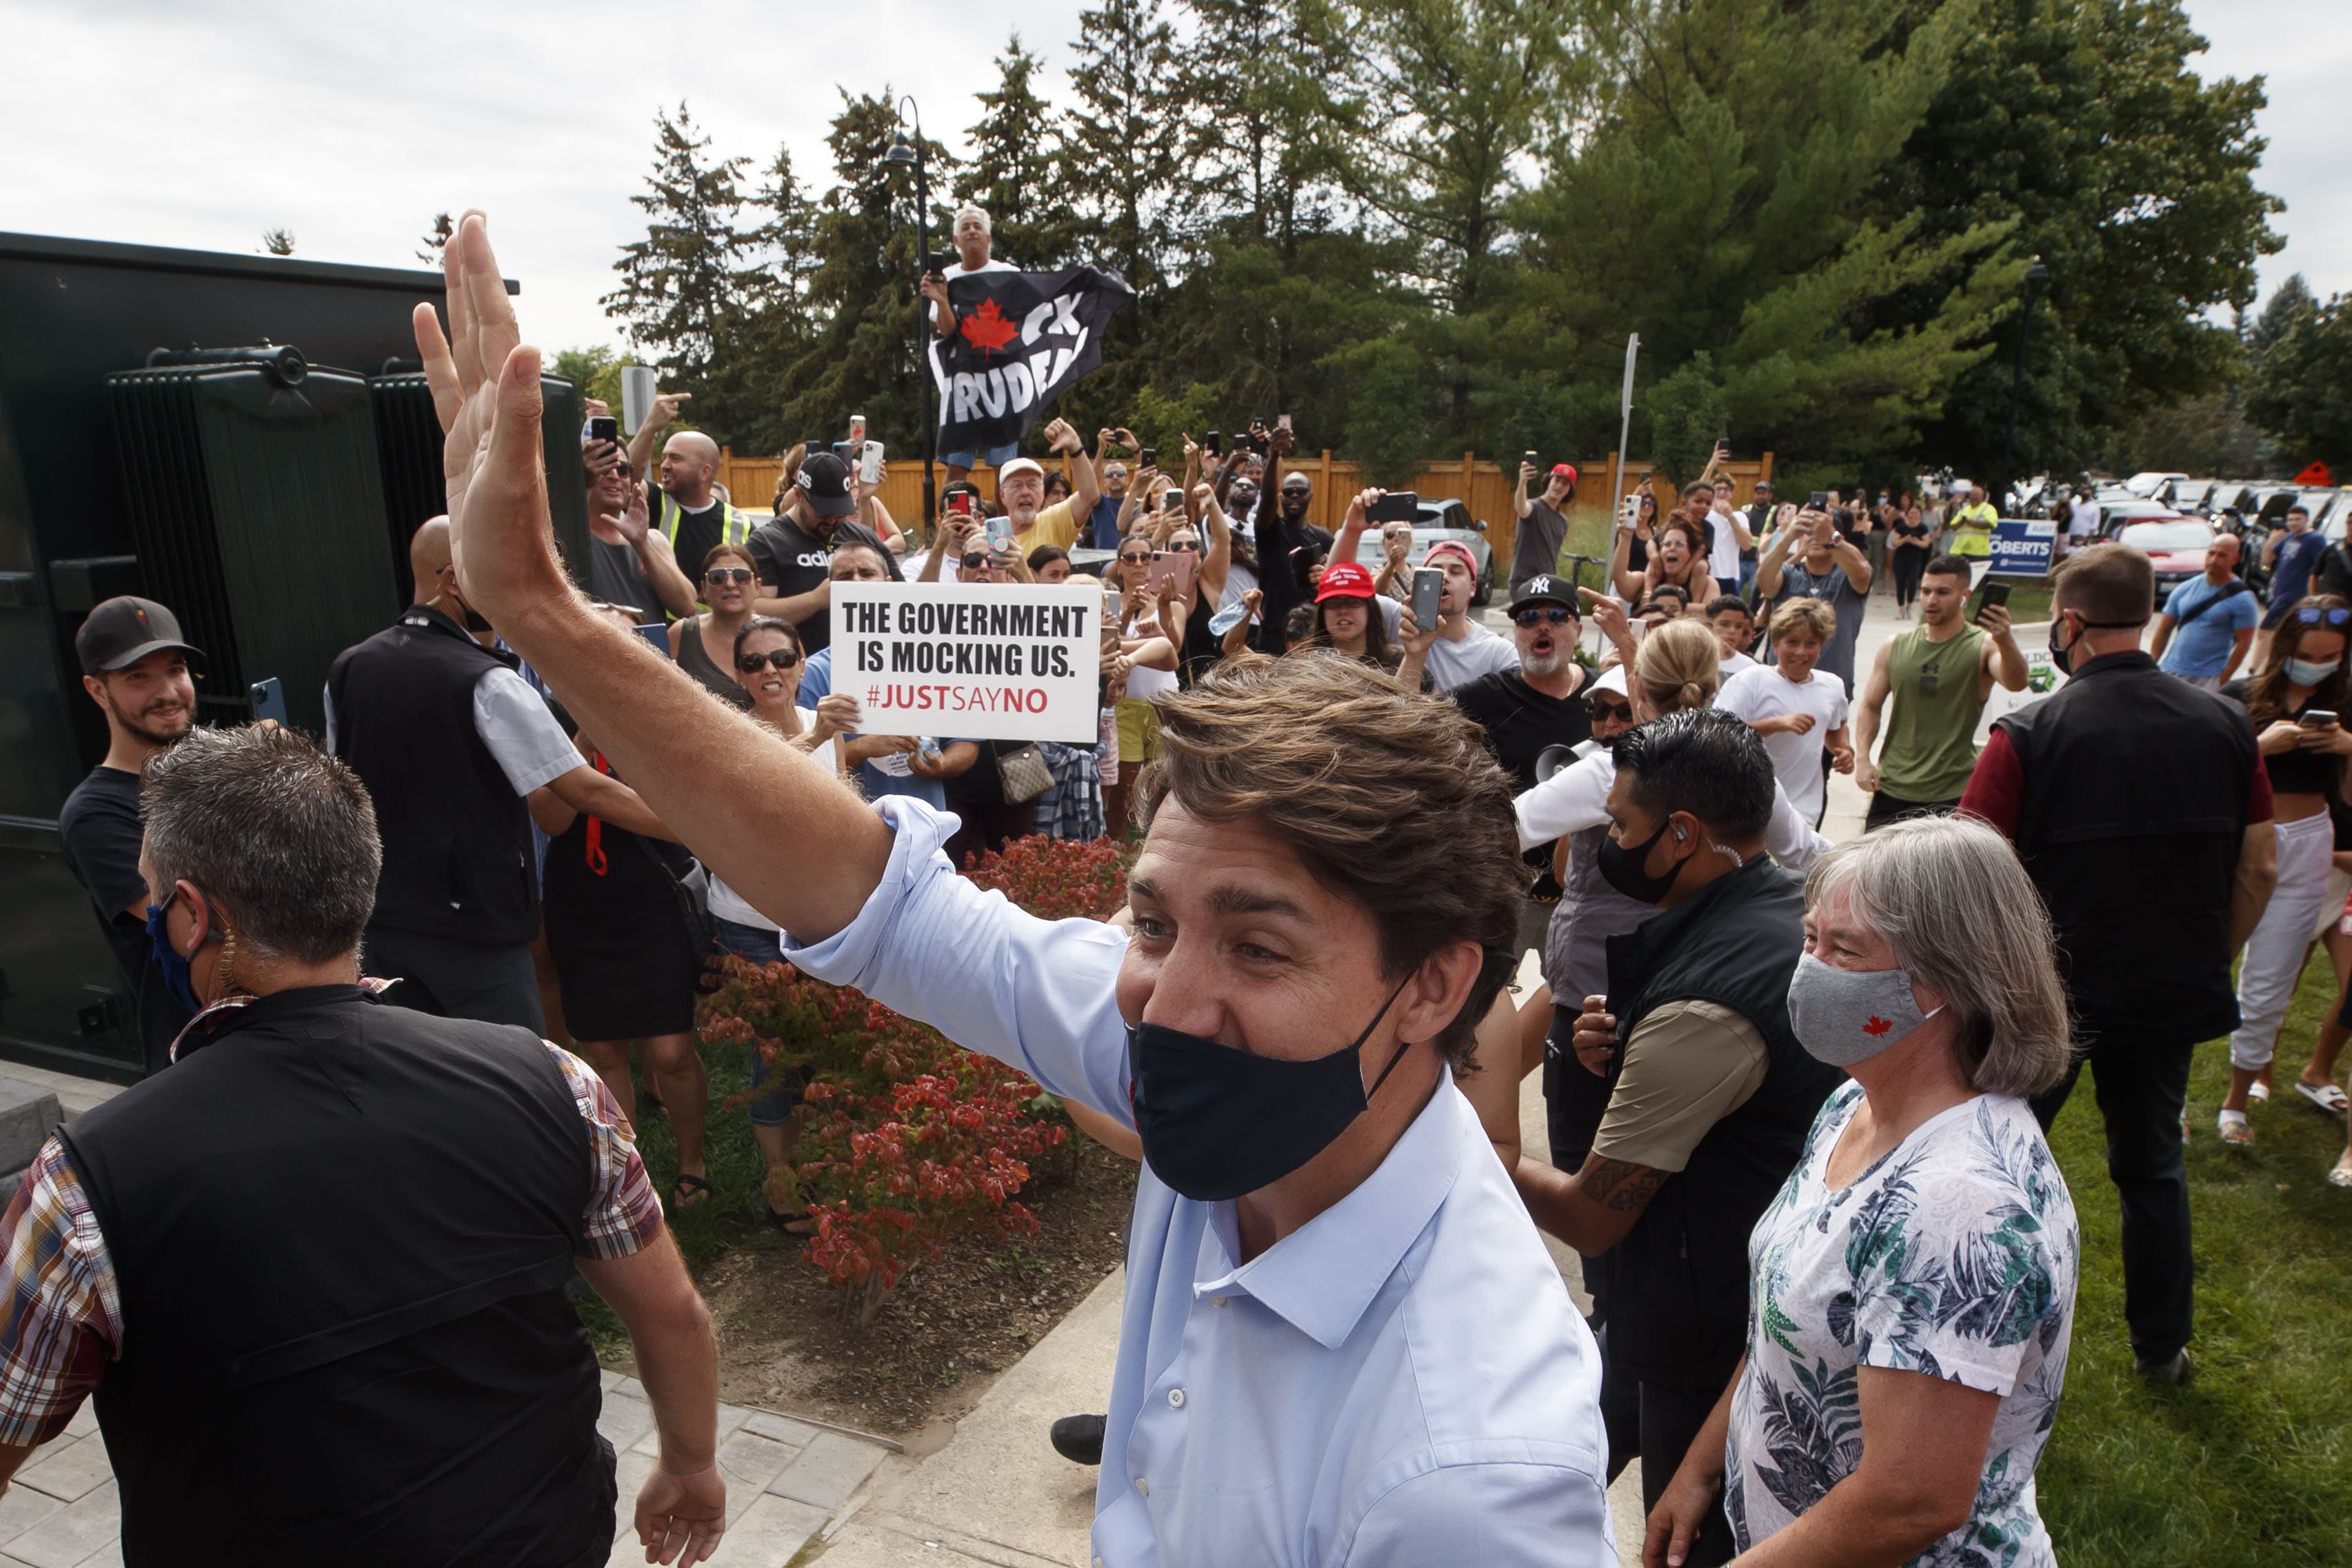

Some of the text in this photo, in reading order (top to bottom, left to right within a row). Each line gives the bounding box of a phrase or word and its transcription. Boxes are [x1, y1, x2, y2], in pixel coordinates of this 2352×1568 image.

[1989, 539, 2051, 556] OBERTS
[1530, 576, 1550, 594] NY
[842, 602, 1088, 638] THE GOVERNMENT
[858, 641, 1076, 678] IS MOCKING US.
[2025, 652, 2052, 663] LDC
[867, 684, 1047, 714] #JUSTSAYNO
